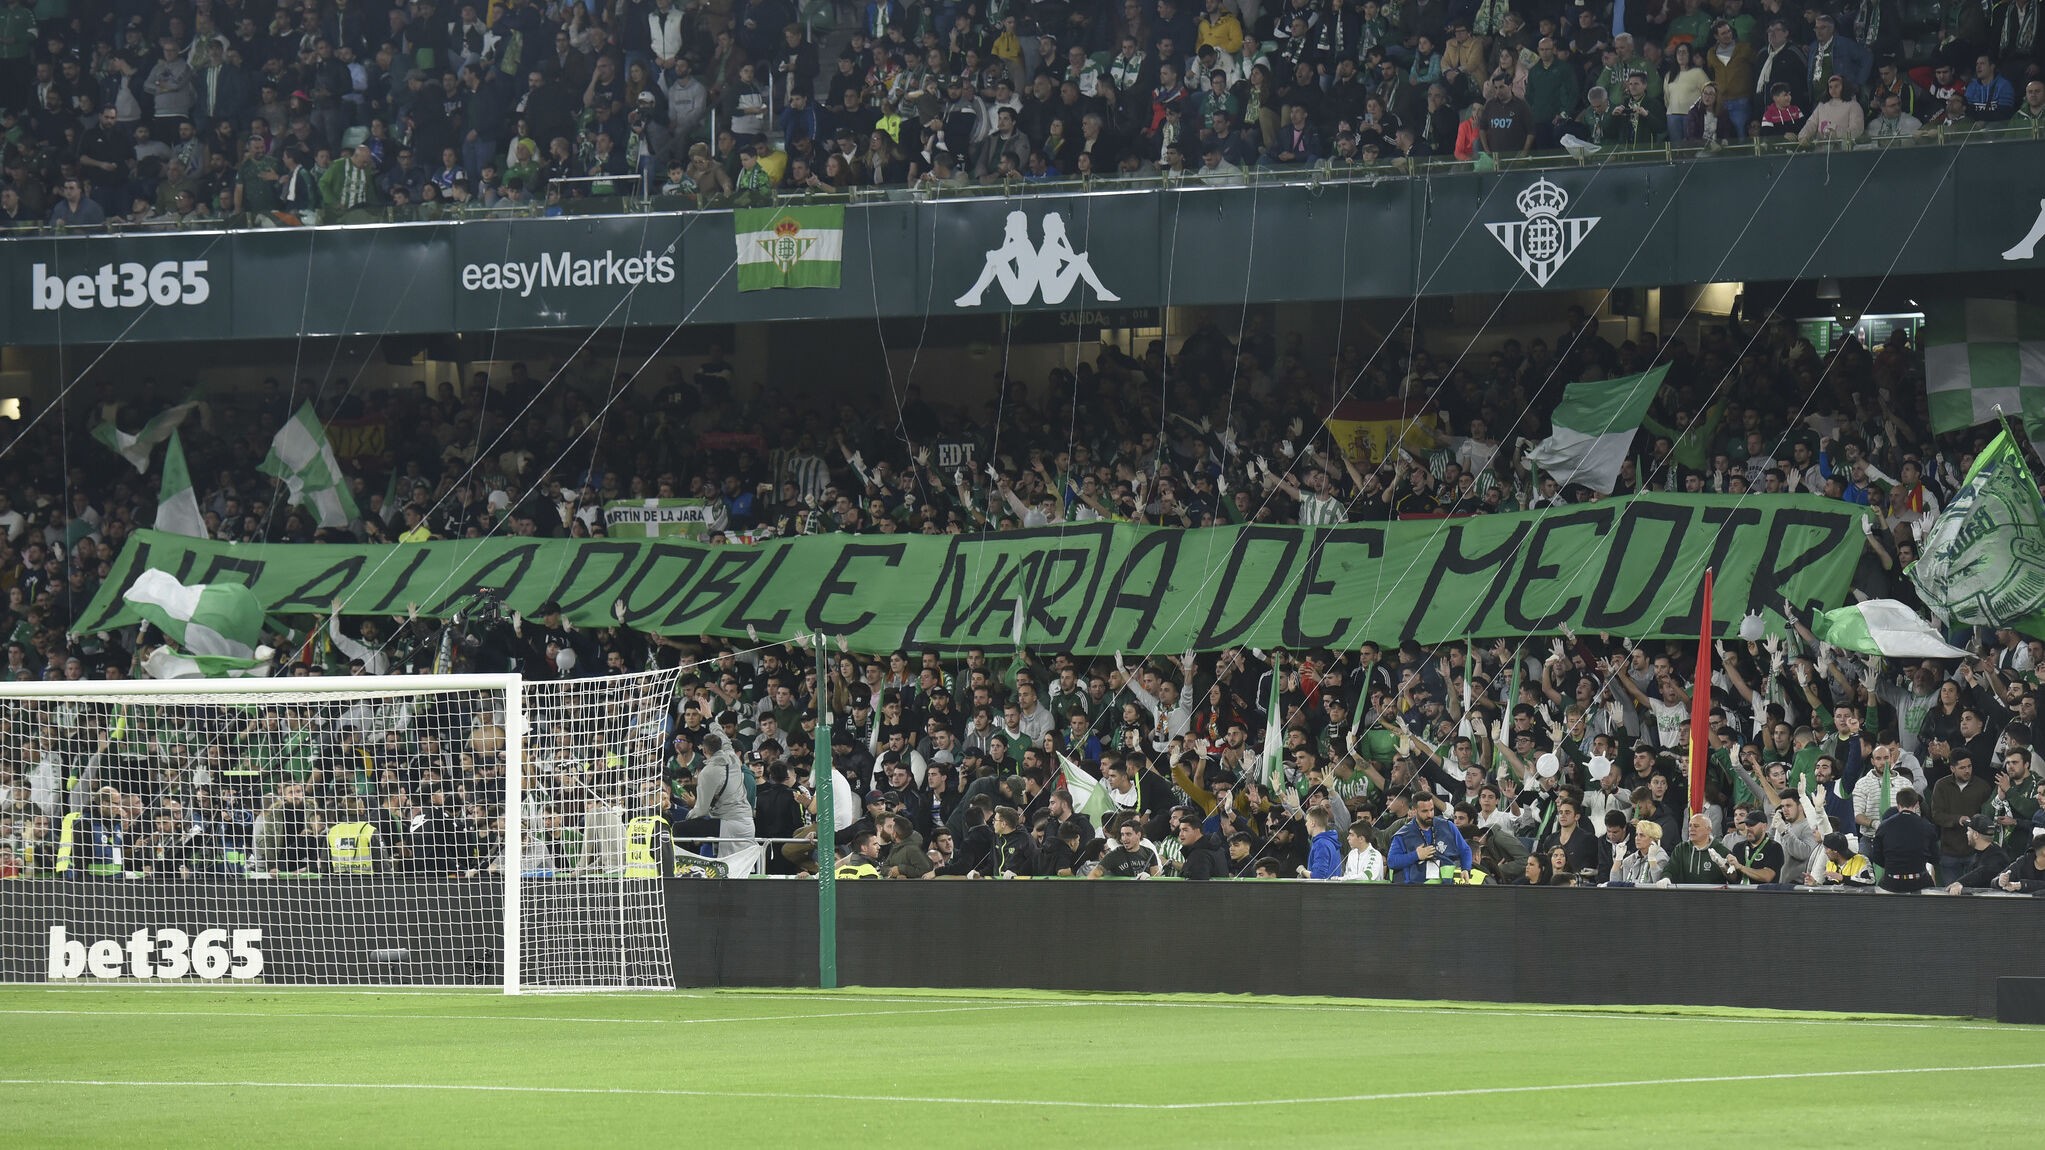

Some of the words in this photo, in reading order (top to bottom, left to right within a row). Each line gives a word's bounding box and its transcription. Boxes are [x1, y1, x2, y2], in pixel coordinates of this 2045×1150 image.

[1490, 118, 1513, 129] 1907
[32, 260, 210, 310] bet365
[462, 249, 676, 297] easyMarkets
[938, 443, 975, 467] EDT
[643, 510, 658, 522] DE
[660, 510, 674, 522] LA
[677, 510, 704, 522] JARA
[526, 541, 907, 636] DOBLE
[1193, 526, 1385, 650] DE
[1397, 501, 1853, 641] MEDIR
[48, 925, 264, 979] bet365
